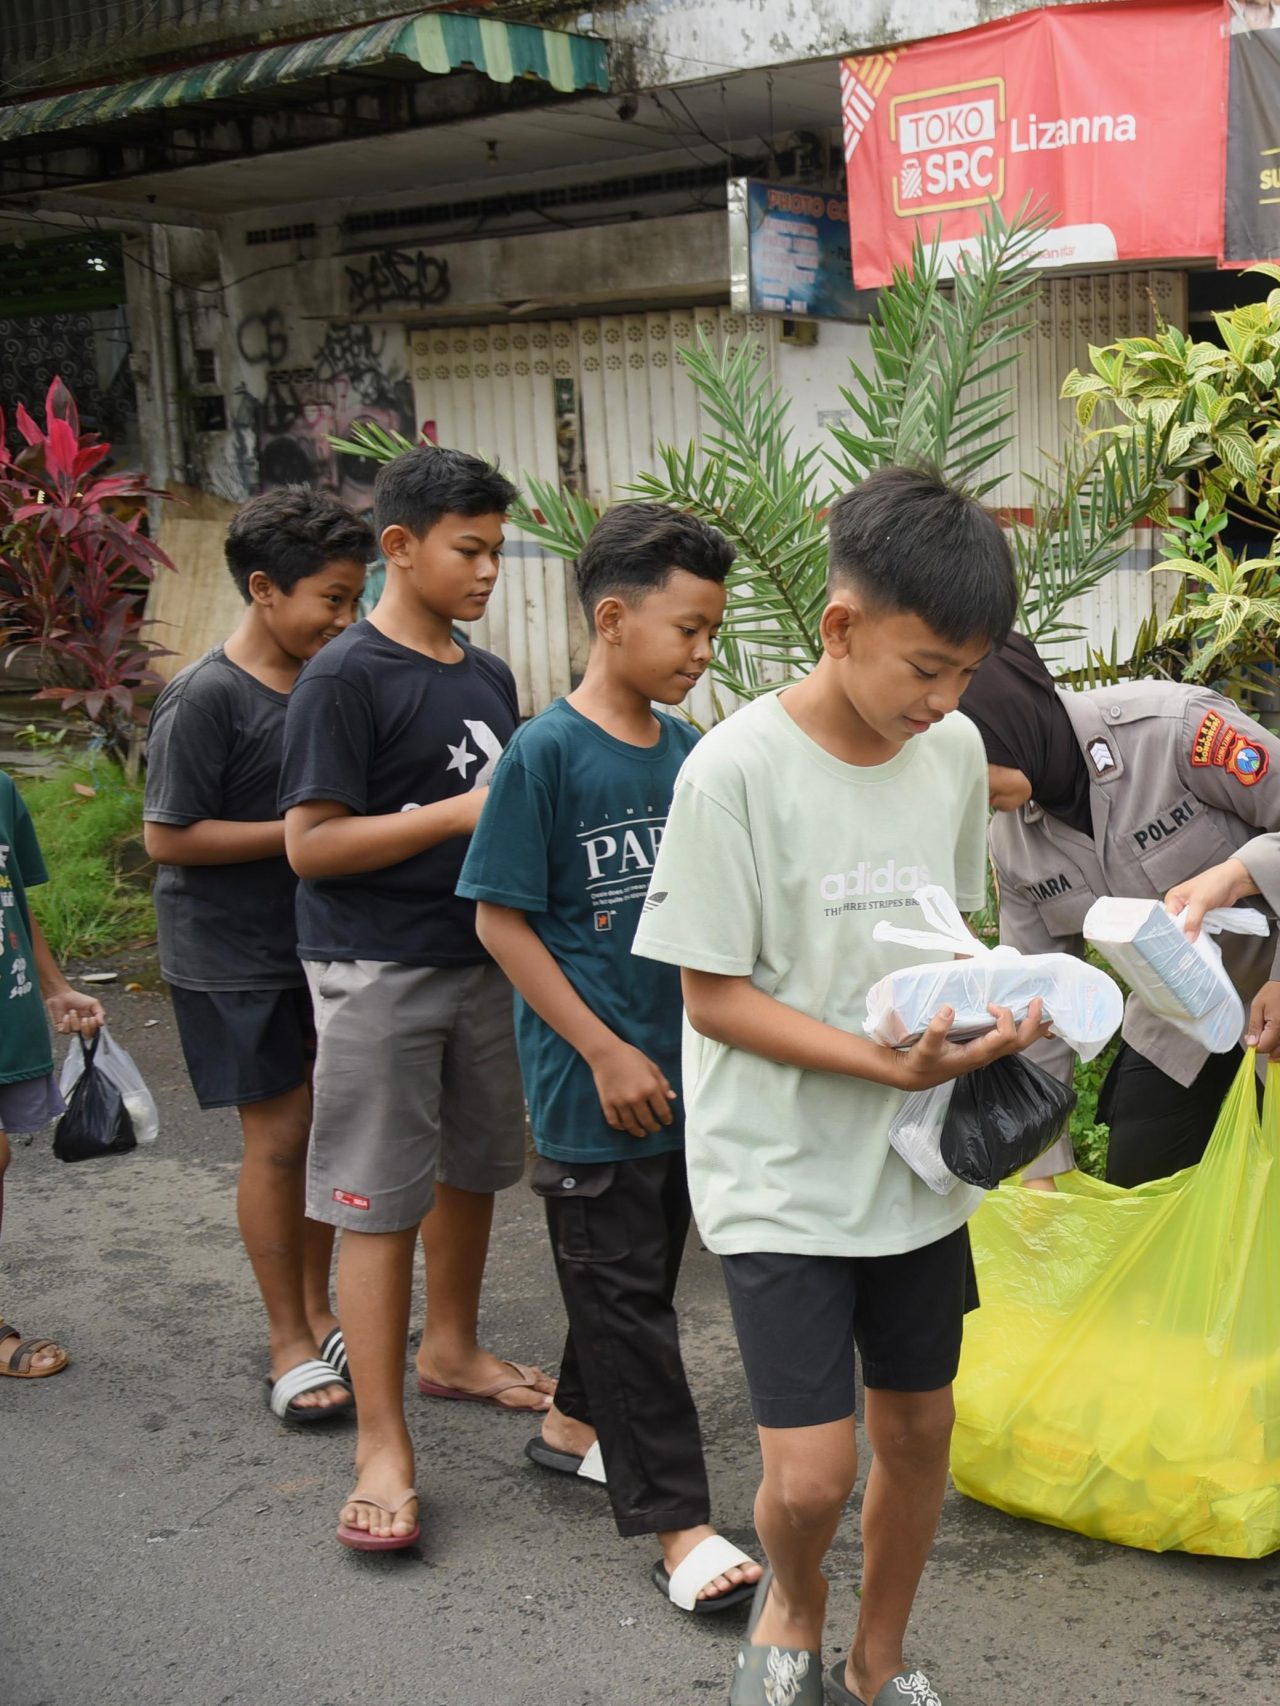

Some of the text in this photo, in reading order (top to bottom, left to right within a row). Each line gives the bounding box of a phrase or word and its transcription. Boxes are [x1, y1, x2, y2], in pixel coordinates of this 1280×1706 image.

[909, 106, 985, 148] TOKO
[1010, 113, 1137, 153] Lizanna
[926, 145, 994, 195] SRC
[767, 188, 825, 218] PHOTO
[1132, 801, 1195, 850] POLRI
[820, 859, 929, 901] adidas
[868, 898, 904, 910] STRIPES
